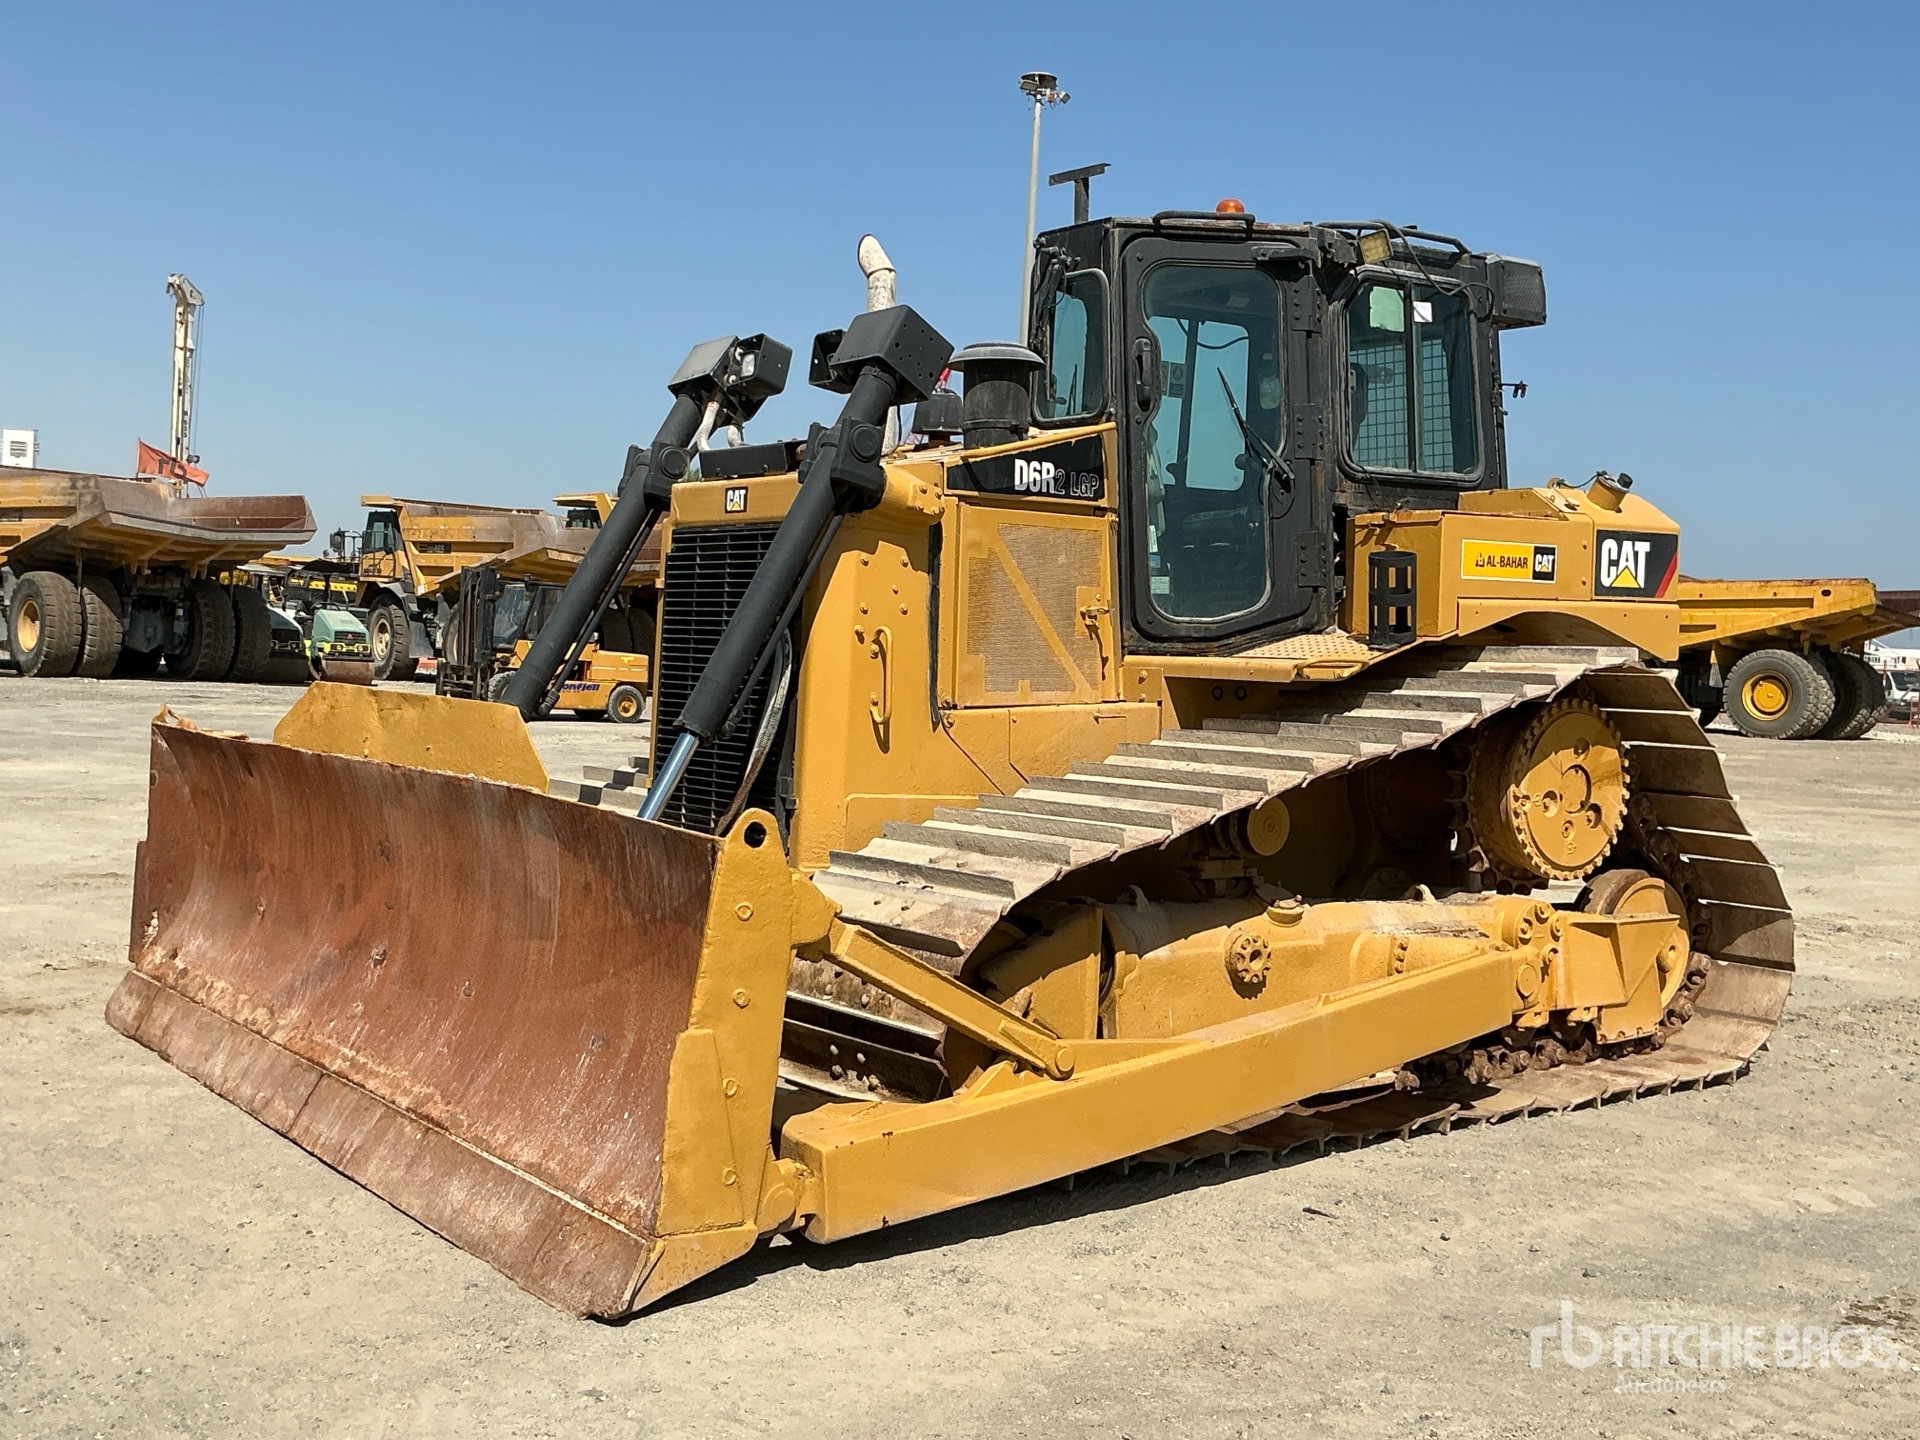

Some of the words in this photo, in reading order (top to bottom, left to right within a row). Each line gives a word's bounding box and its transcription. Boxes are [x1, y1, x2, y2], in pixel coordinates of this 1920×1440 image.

[1070, 471, 1100, 498] LGP
[726, 489, 747, 512] CAT
[1486, 554, 1529, 570] AL-BAHAR
[1534, 553, 1555, 573] CAT
[1600, 538, 1651, 589] CAT
